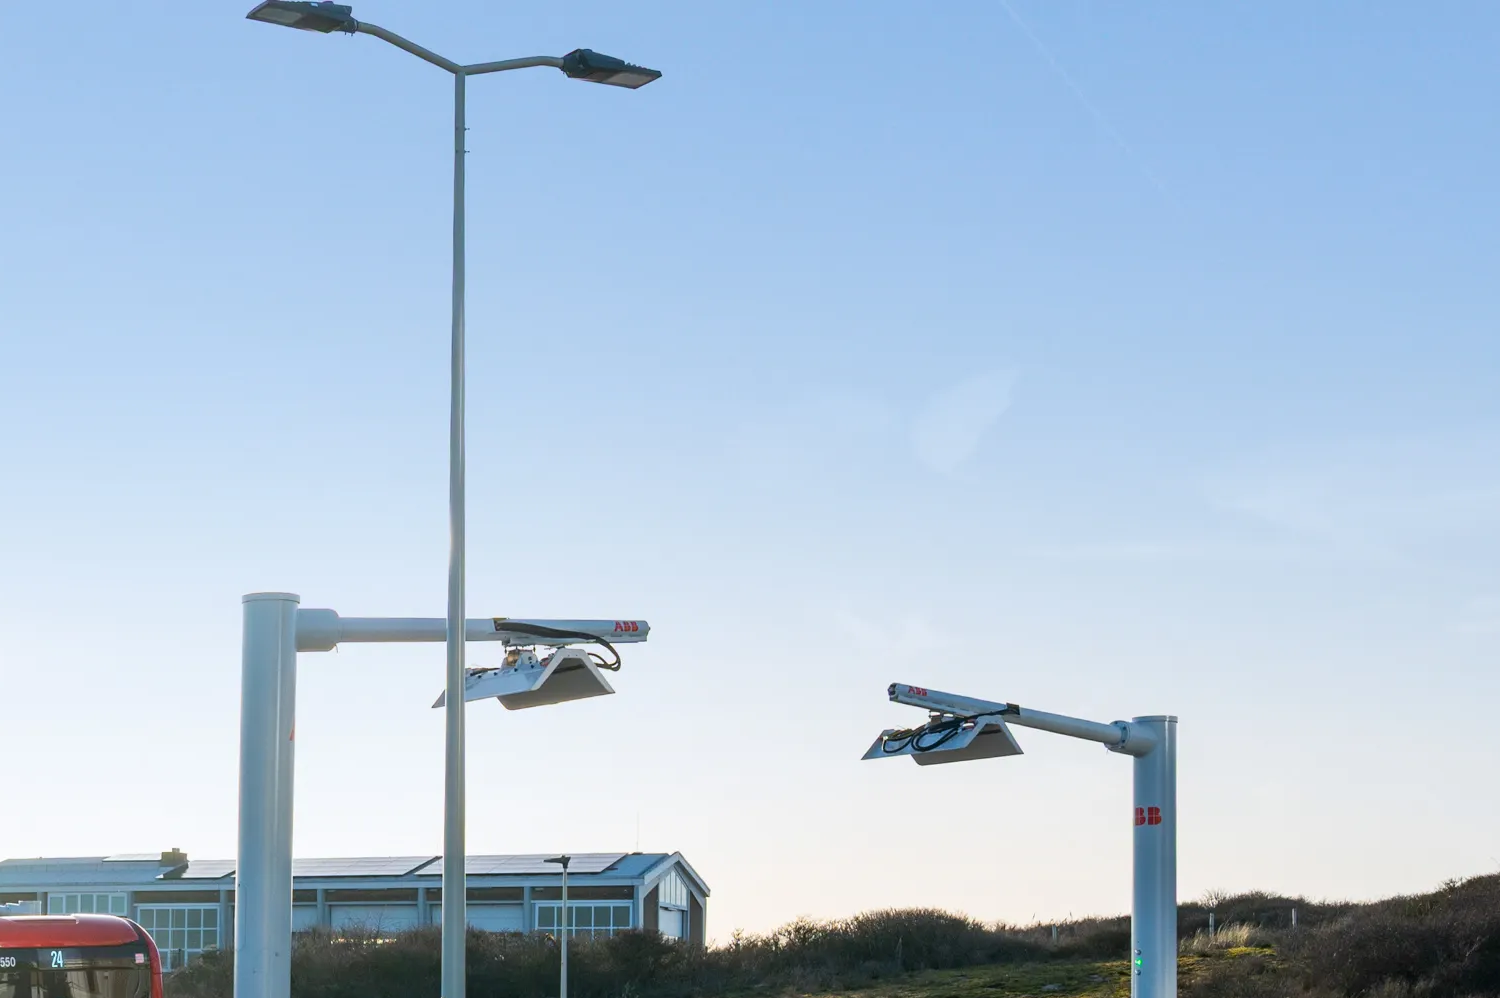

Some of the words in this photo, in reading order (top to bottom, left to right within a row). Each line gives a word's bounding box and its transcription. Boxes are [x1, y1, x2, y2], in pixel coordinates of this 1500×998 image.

[614, 620, 639, 632] ABB
[908, 686, 928, 697] ABB
[1134, 806, 1162, 826] BB
[51, 950, 64, 968] 24
